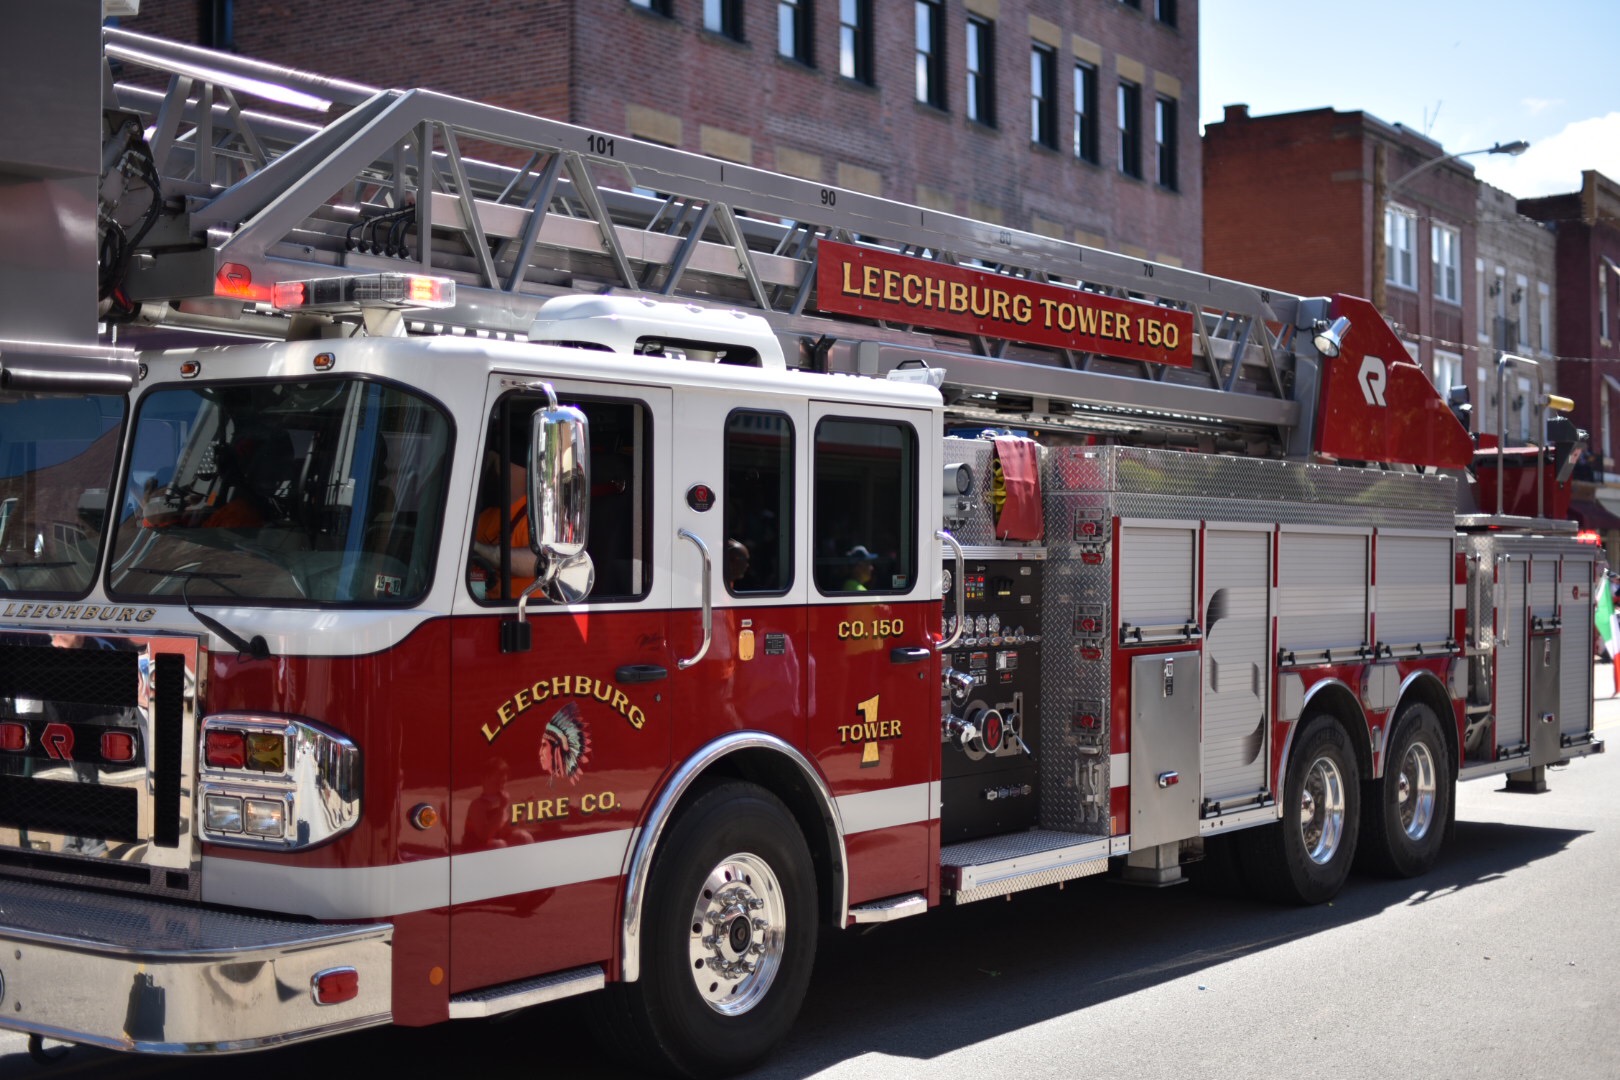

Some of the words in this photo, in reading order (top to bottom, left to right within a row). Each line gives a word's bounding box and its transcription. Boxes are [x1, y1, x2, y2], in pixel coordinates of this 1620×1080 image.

[587, 134, 614, 157] 101
[820, 188, 836, 206] 90
[1000, 230, 1011, 245] 80
[1143, 263, 1153, 278] 70
[842, 262, 1032, 324] LEECHBURG
[1039, 299, 1131, 342] TOWER
[1137, 317, 1179, 349] 150
[1261, 291, 1270, 304] 60
[3, 603, 157, 622] LEECHBURG
[838, 621, 869, 639] CO.
[872, 619, 904, 637] 150
[481, 675, 646, 742] LEECHBURG
[838, 720, 902, 743] TOWER
[857, 694, 880, 764] 1
[511, 797, 569, 823] FIRE
[580, 791, 621, 813] CO.
